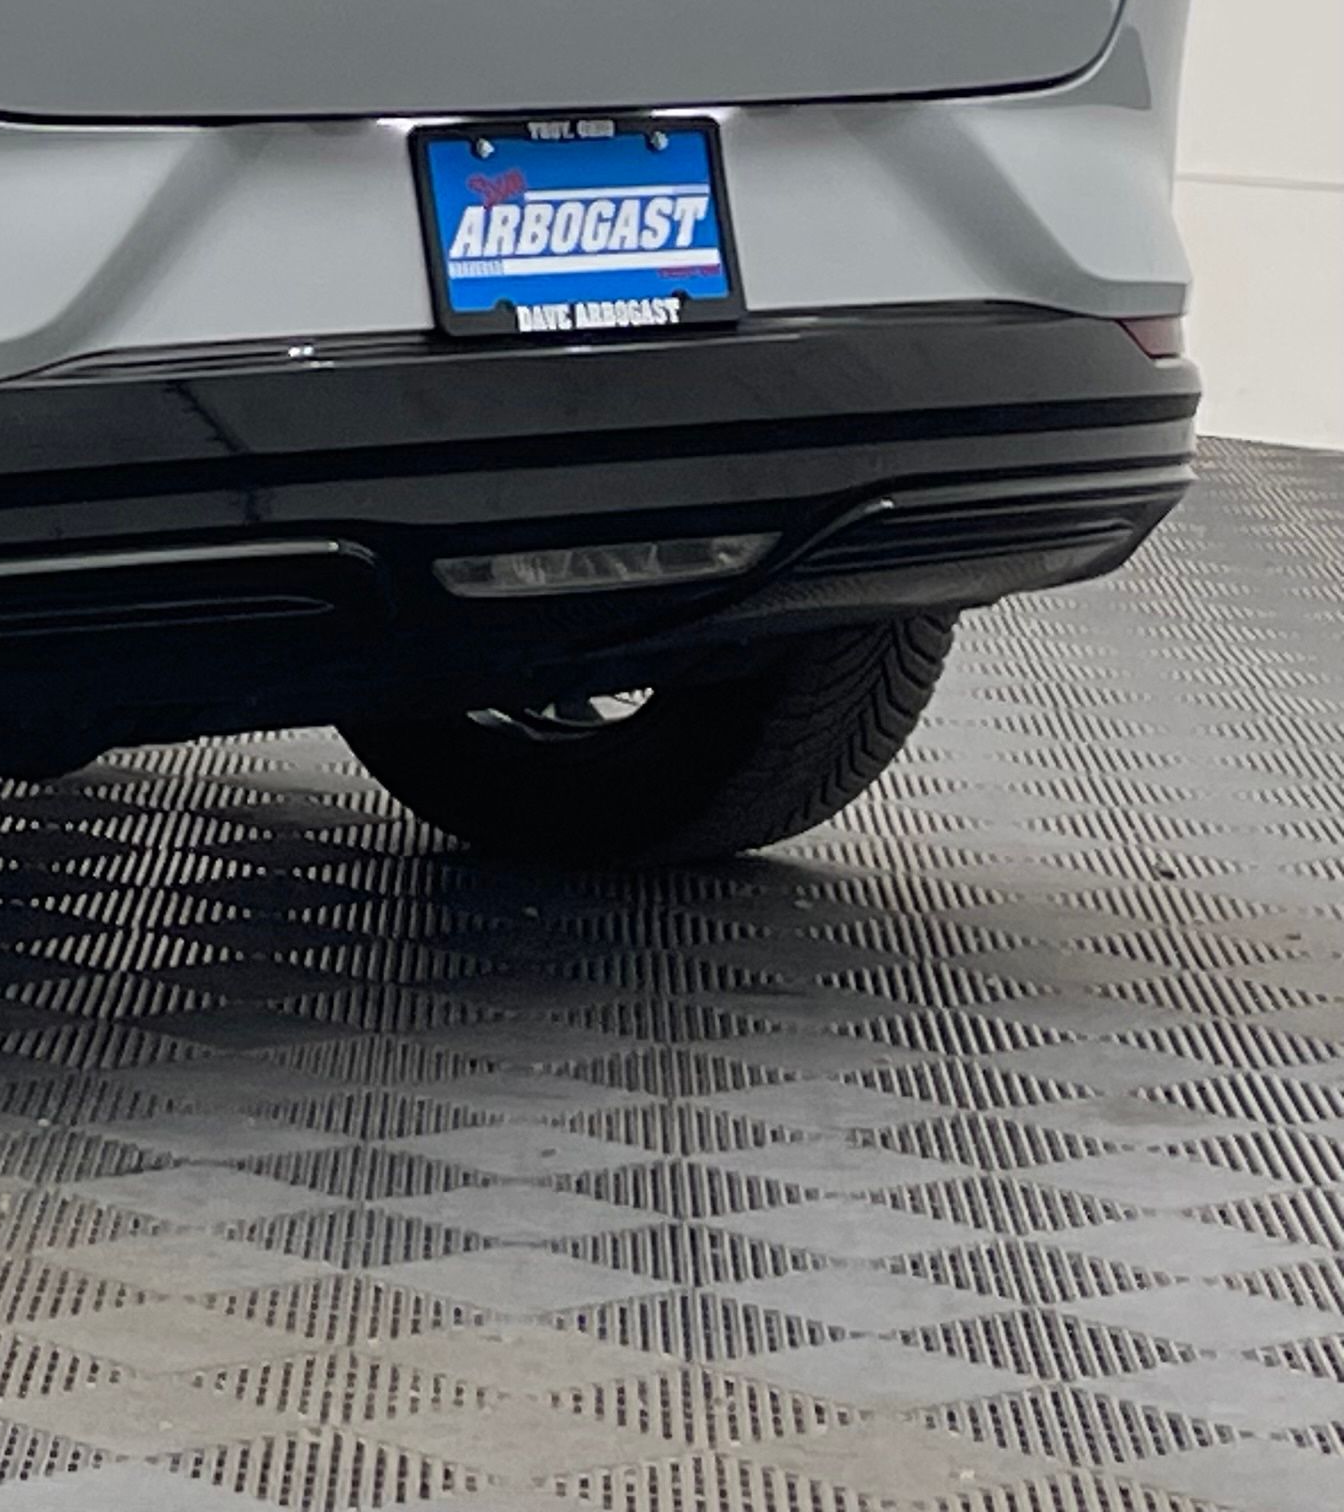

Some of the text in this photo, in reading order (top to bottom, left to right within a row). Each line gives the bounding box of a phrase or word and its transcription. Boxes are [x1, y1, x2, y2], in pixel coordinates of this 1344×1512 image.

[449, 196, 709, 259] ARBOGAST
[516, 297, 681, 332] DAVE ARBOGAST
